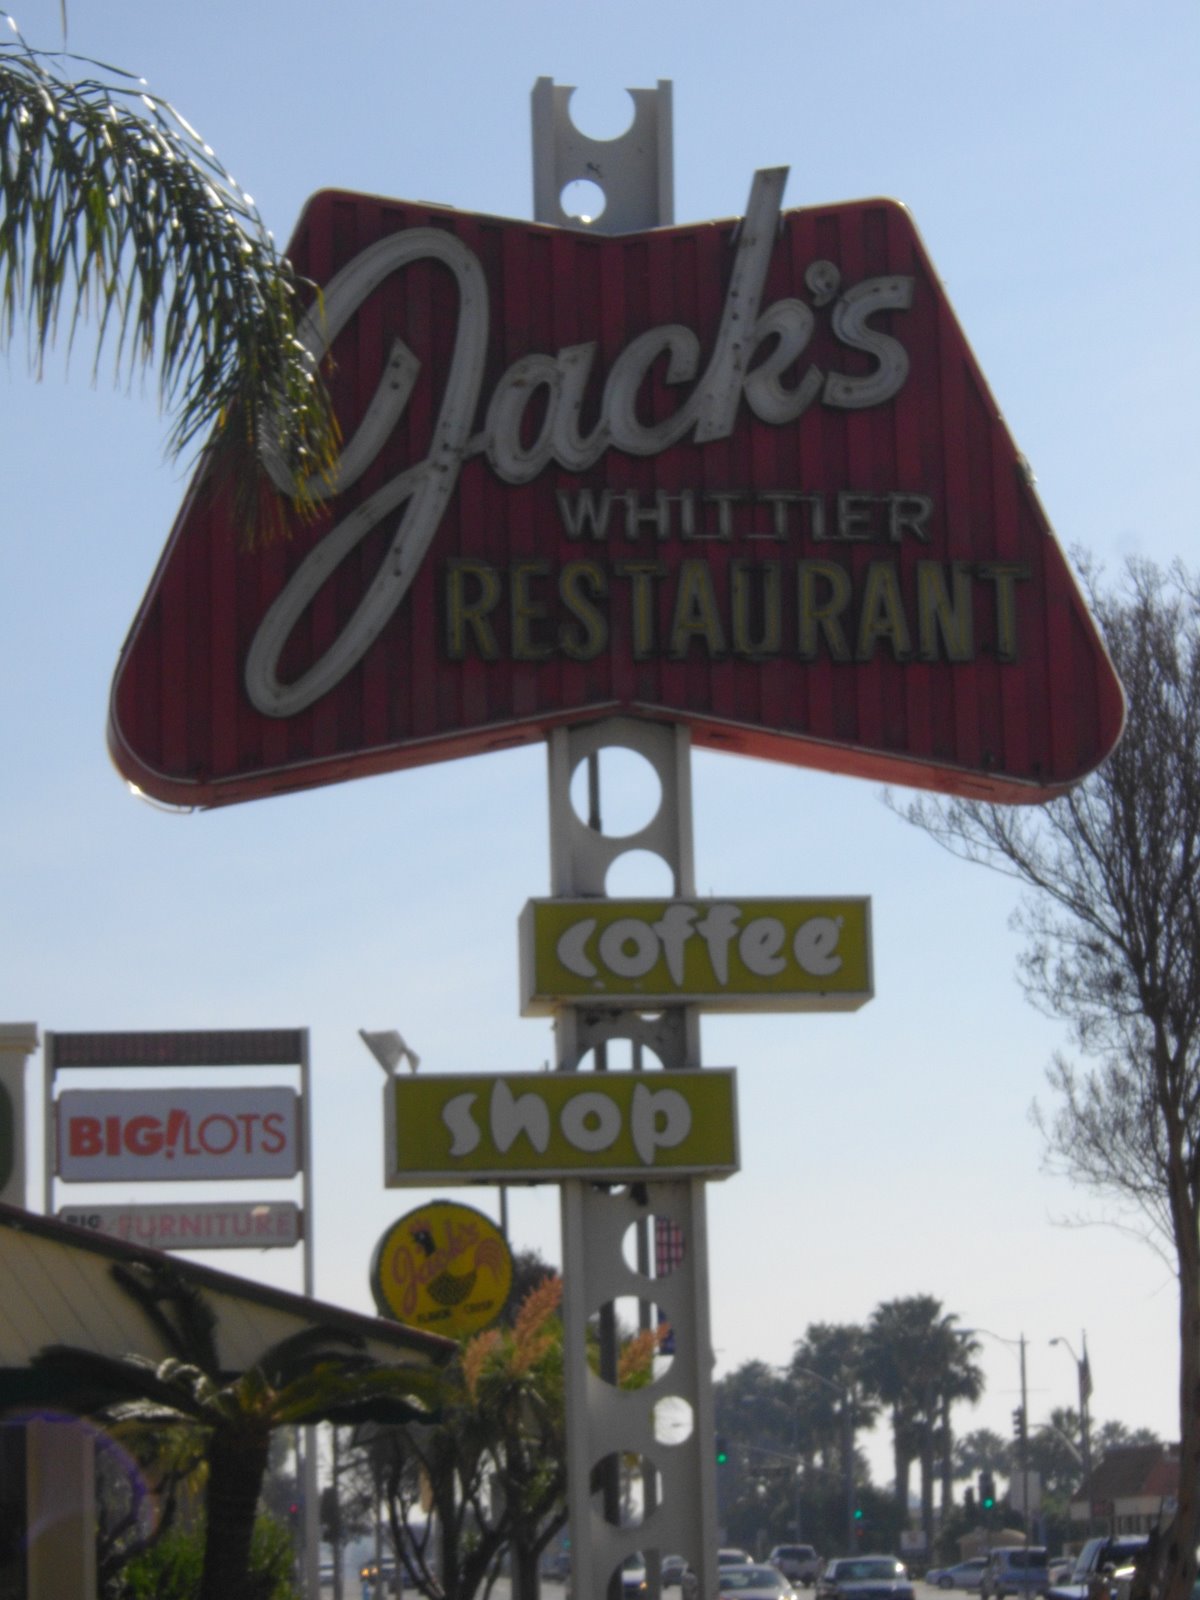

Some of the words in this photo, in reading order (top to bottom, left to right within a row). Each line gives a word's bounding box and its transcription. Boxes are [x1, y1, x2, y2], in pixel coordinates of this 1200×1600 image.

[245, 165, 914, 718] Jack's
[555, 488, 935, 543] WHITTIER
[442, 556, 1032, 663] RESTAURANT
[556, 903, 843, 987] coffee
[441, 1078, 692, 1166] shop
[118, 1211, 291, 1238] FURNITURE
